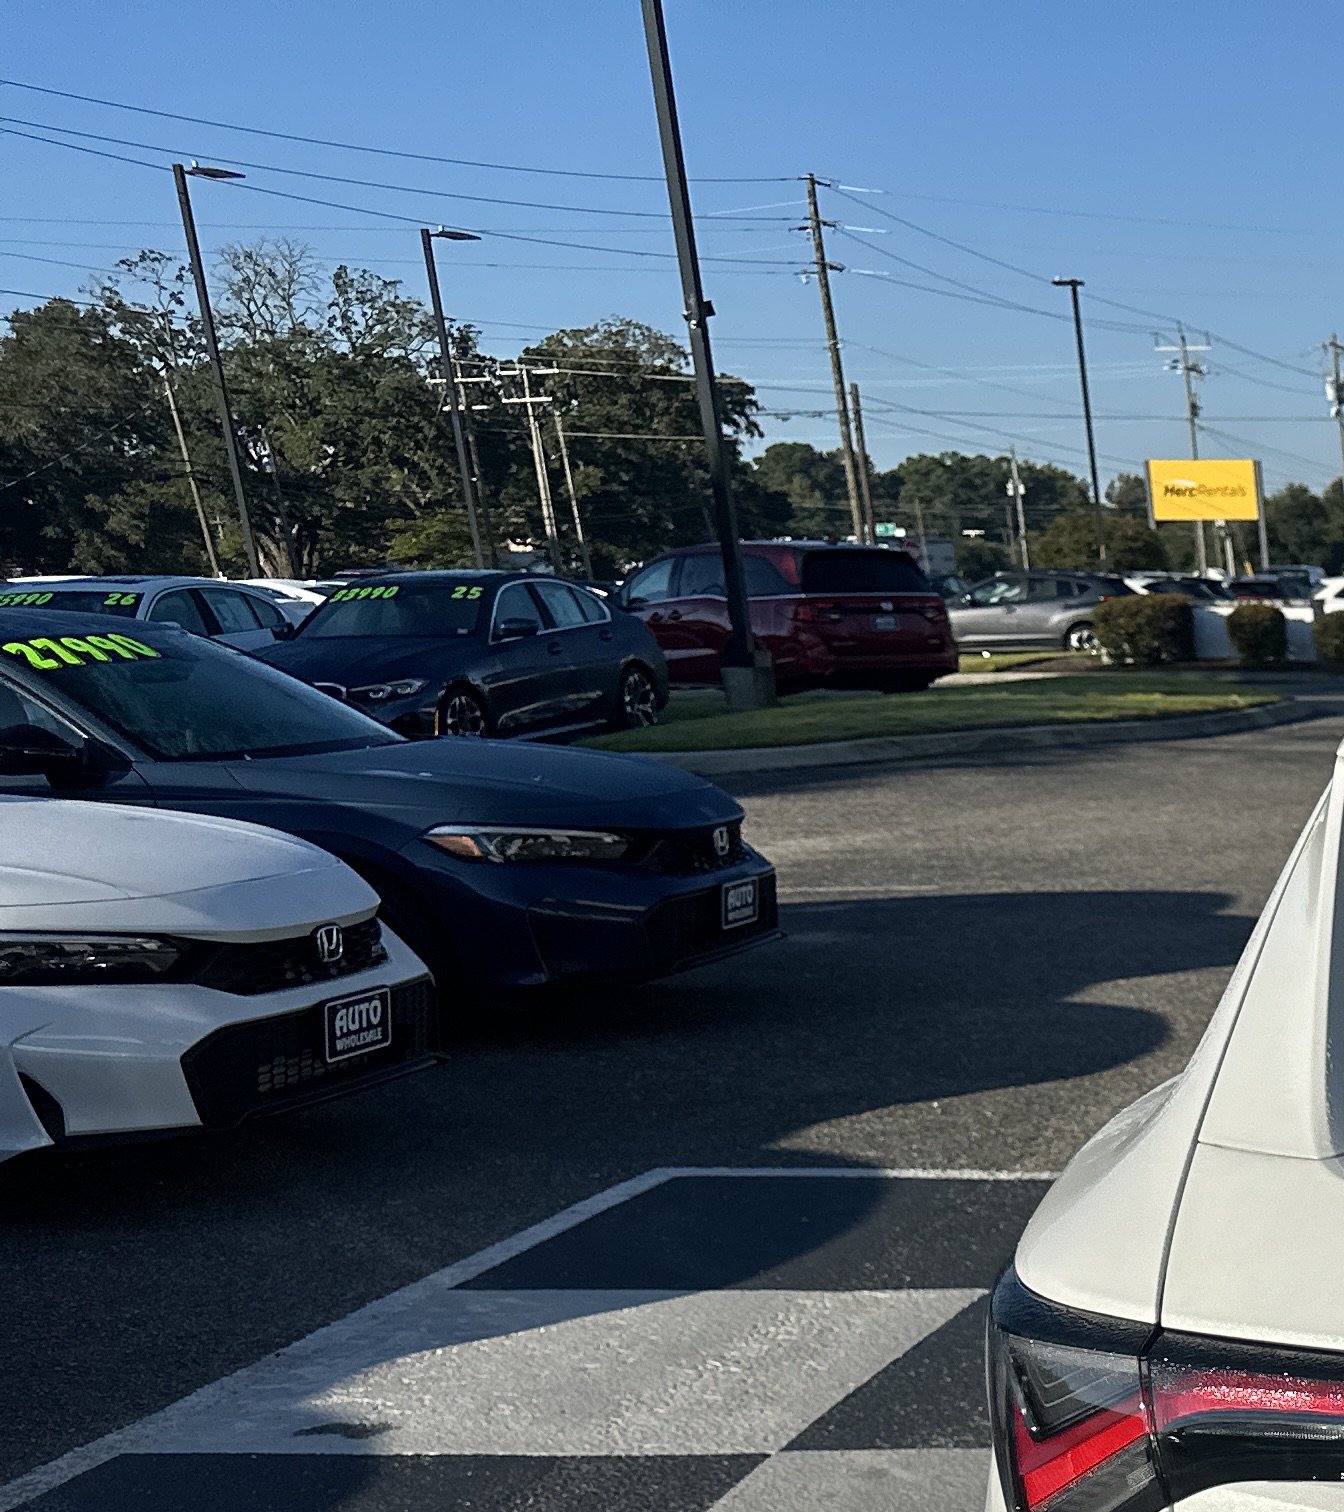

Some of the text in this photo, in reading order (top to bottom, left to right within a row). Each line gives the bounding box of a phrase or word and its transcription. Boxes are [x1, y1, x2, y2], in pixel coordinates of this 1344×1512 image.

[104, 593, 137, 605] 26
[451, 585, 484, 600] 25
[2, 633, 161, 670] 27990
[335, 1000, 381, 1037] AUTO
[336, 1027, 382, 1051] WHOLESALE
